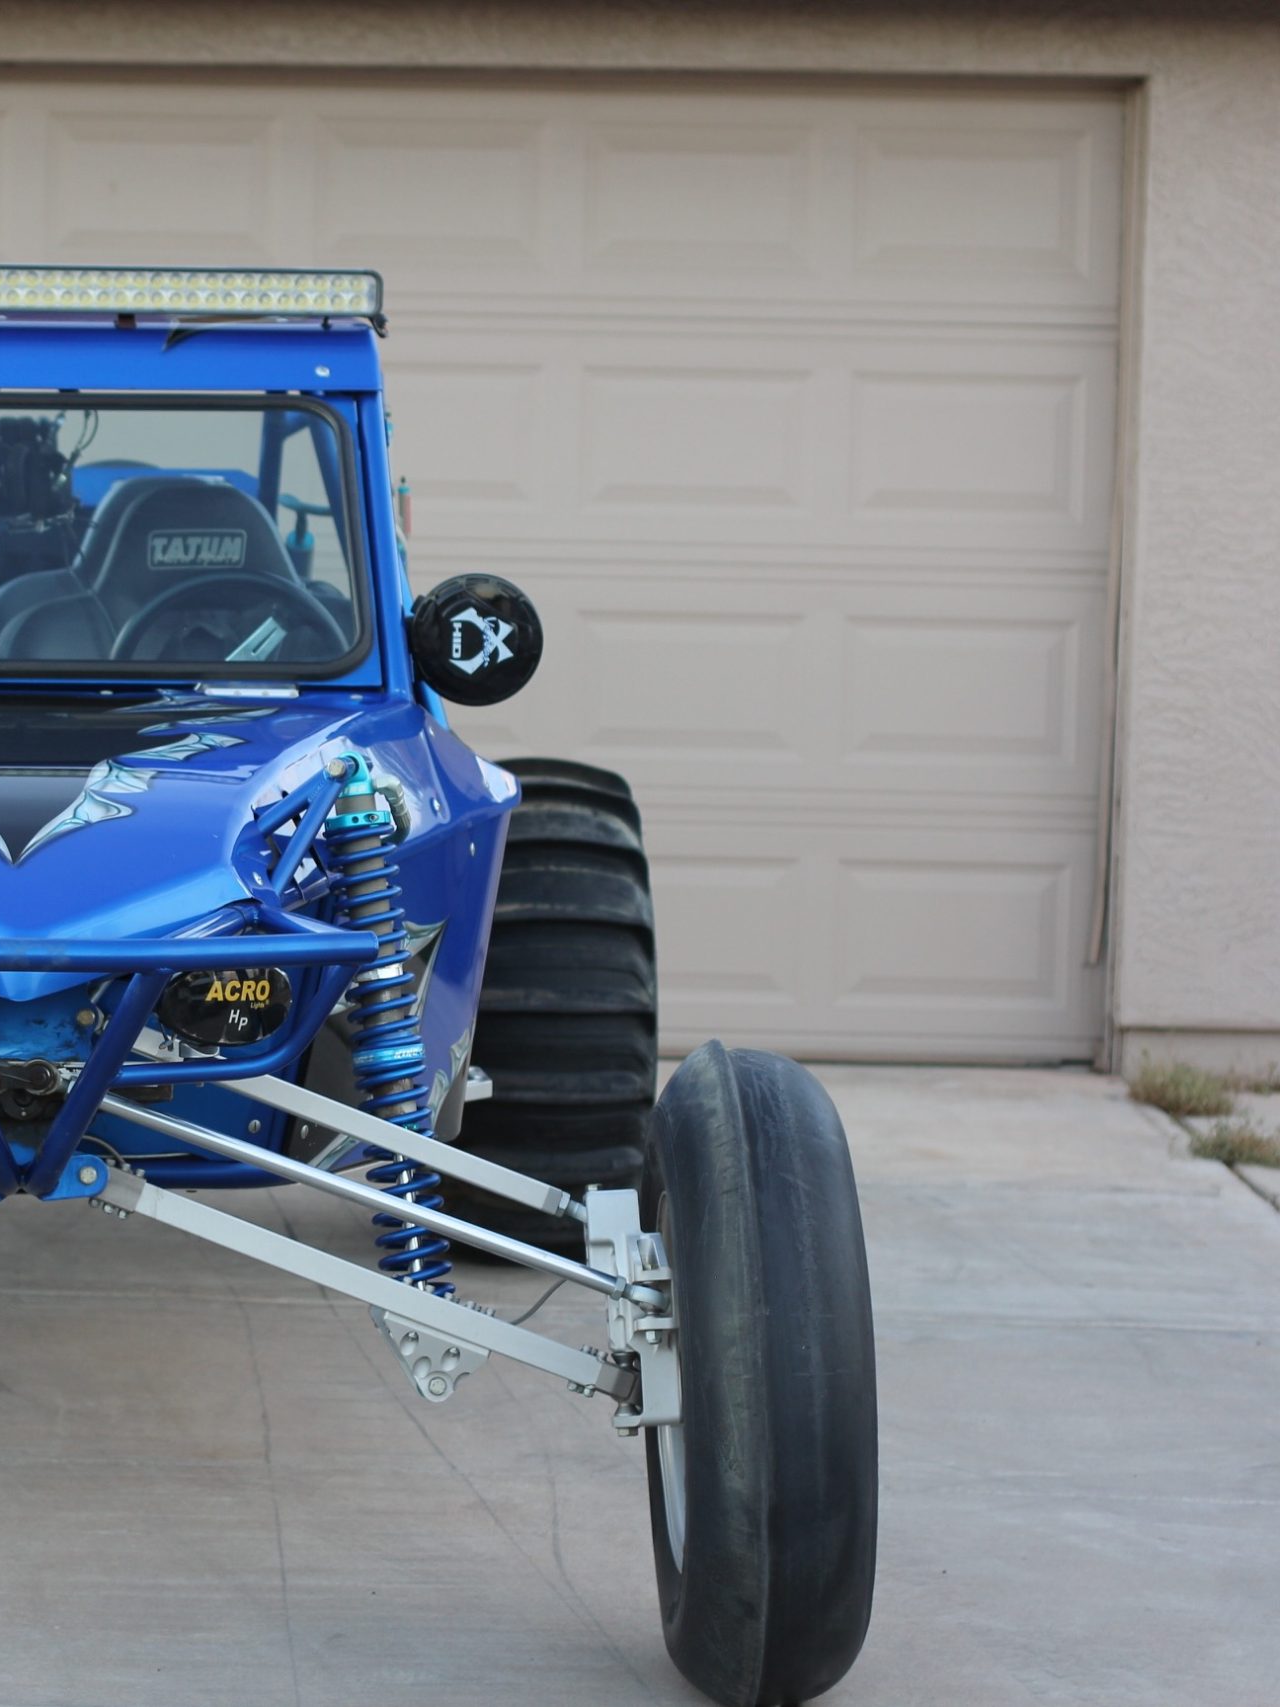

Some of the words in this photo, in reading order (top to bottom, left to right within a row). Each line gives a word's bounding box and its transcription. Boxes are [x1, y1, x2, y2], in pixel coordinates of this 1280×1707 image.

[153, 536, 242, 564] TATUM
[452, 622, 462, 658] HID
[205, 980, 270, 1002] ACRO
